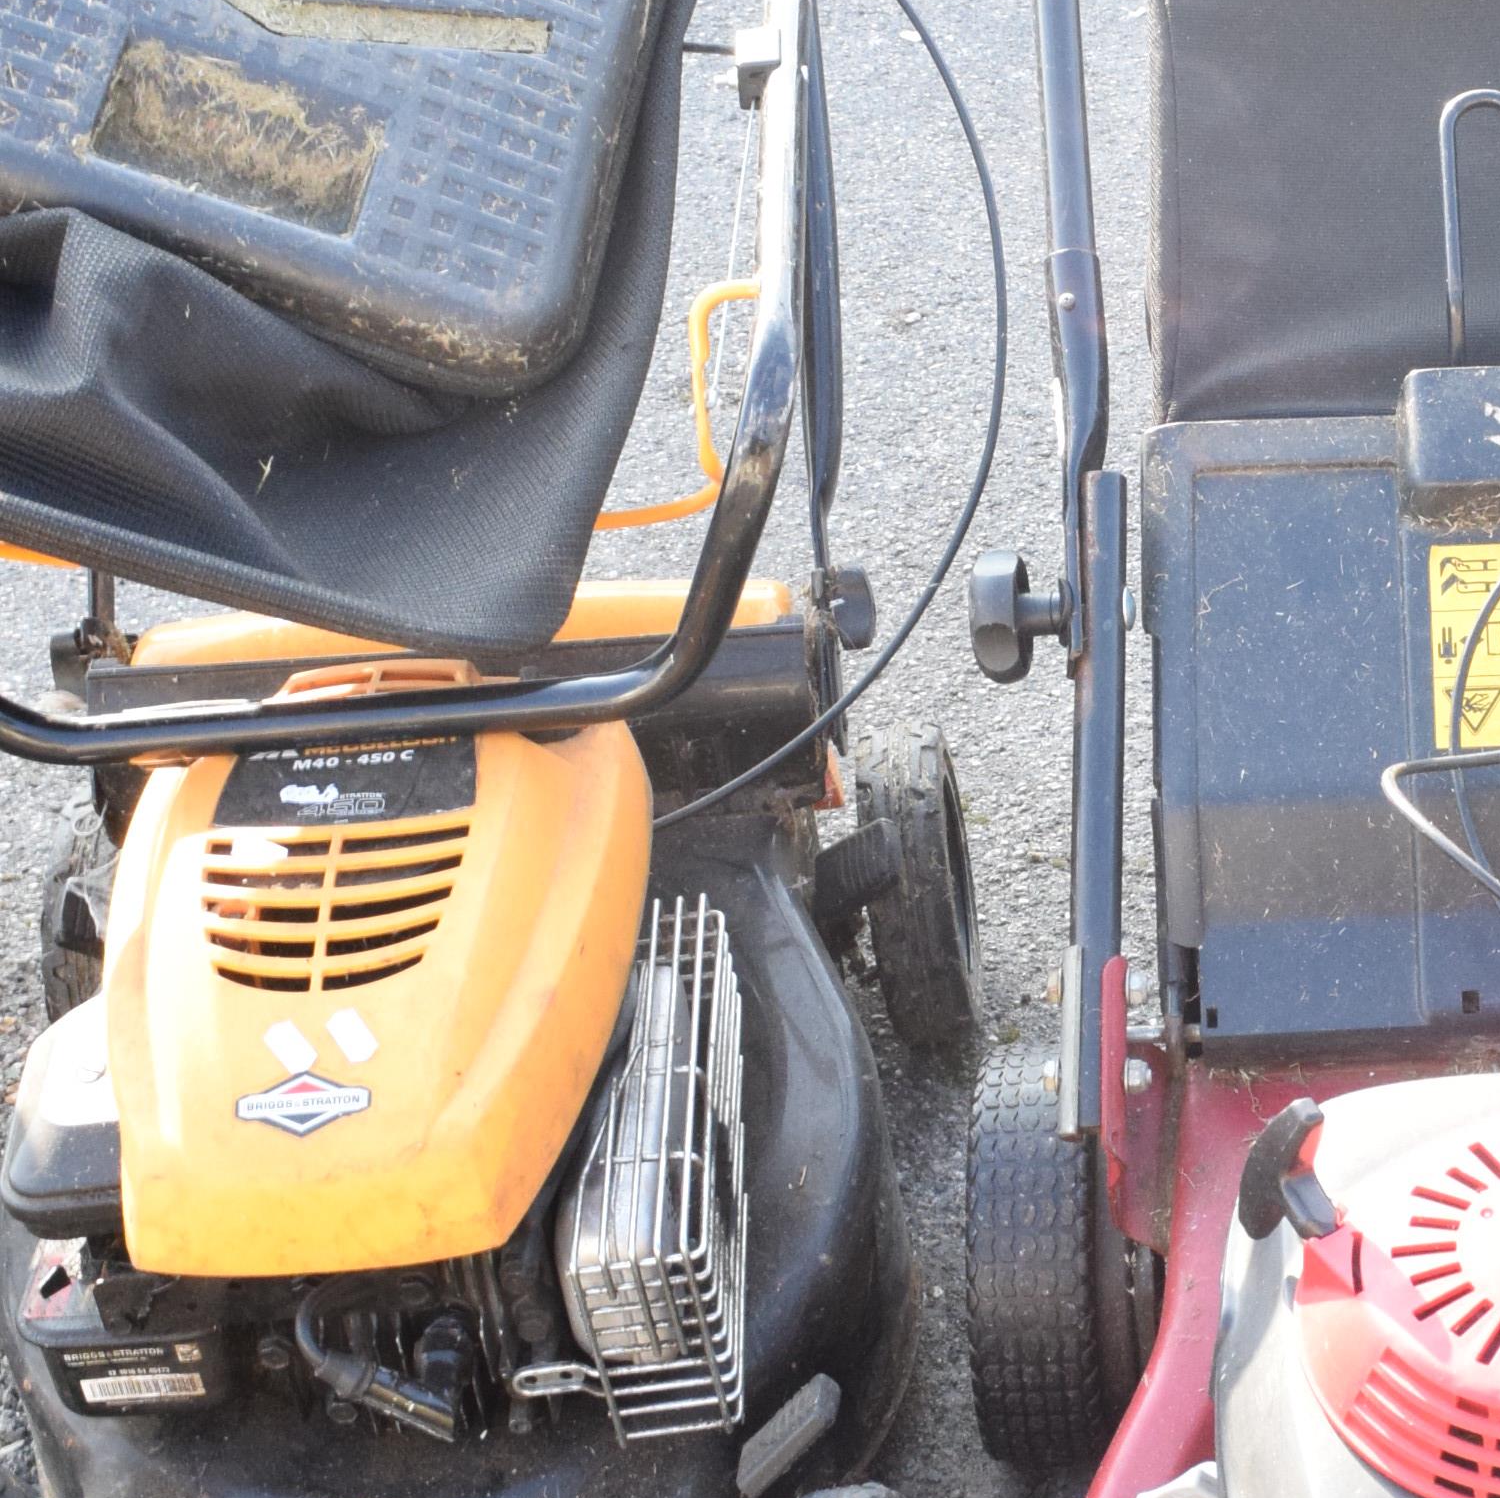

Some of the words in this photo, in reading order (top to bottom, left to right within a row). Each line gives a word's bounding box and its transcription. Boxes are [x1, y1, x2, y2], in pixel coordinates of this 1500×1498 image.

[292, 756, 339, 771] M40
[357, 751, 396, 766] 450
[400, 749, 415, 761] C
[297, 798, 385, 816] 450
[247, 1100, 293, 1111] BRIGGS
[302, 1094, 361, 1107] STRATTON
[63, 1351, 105, 1362] BRIGGS
[112, 1348, 164, 1358] STRATTON
